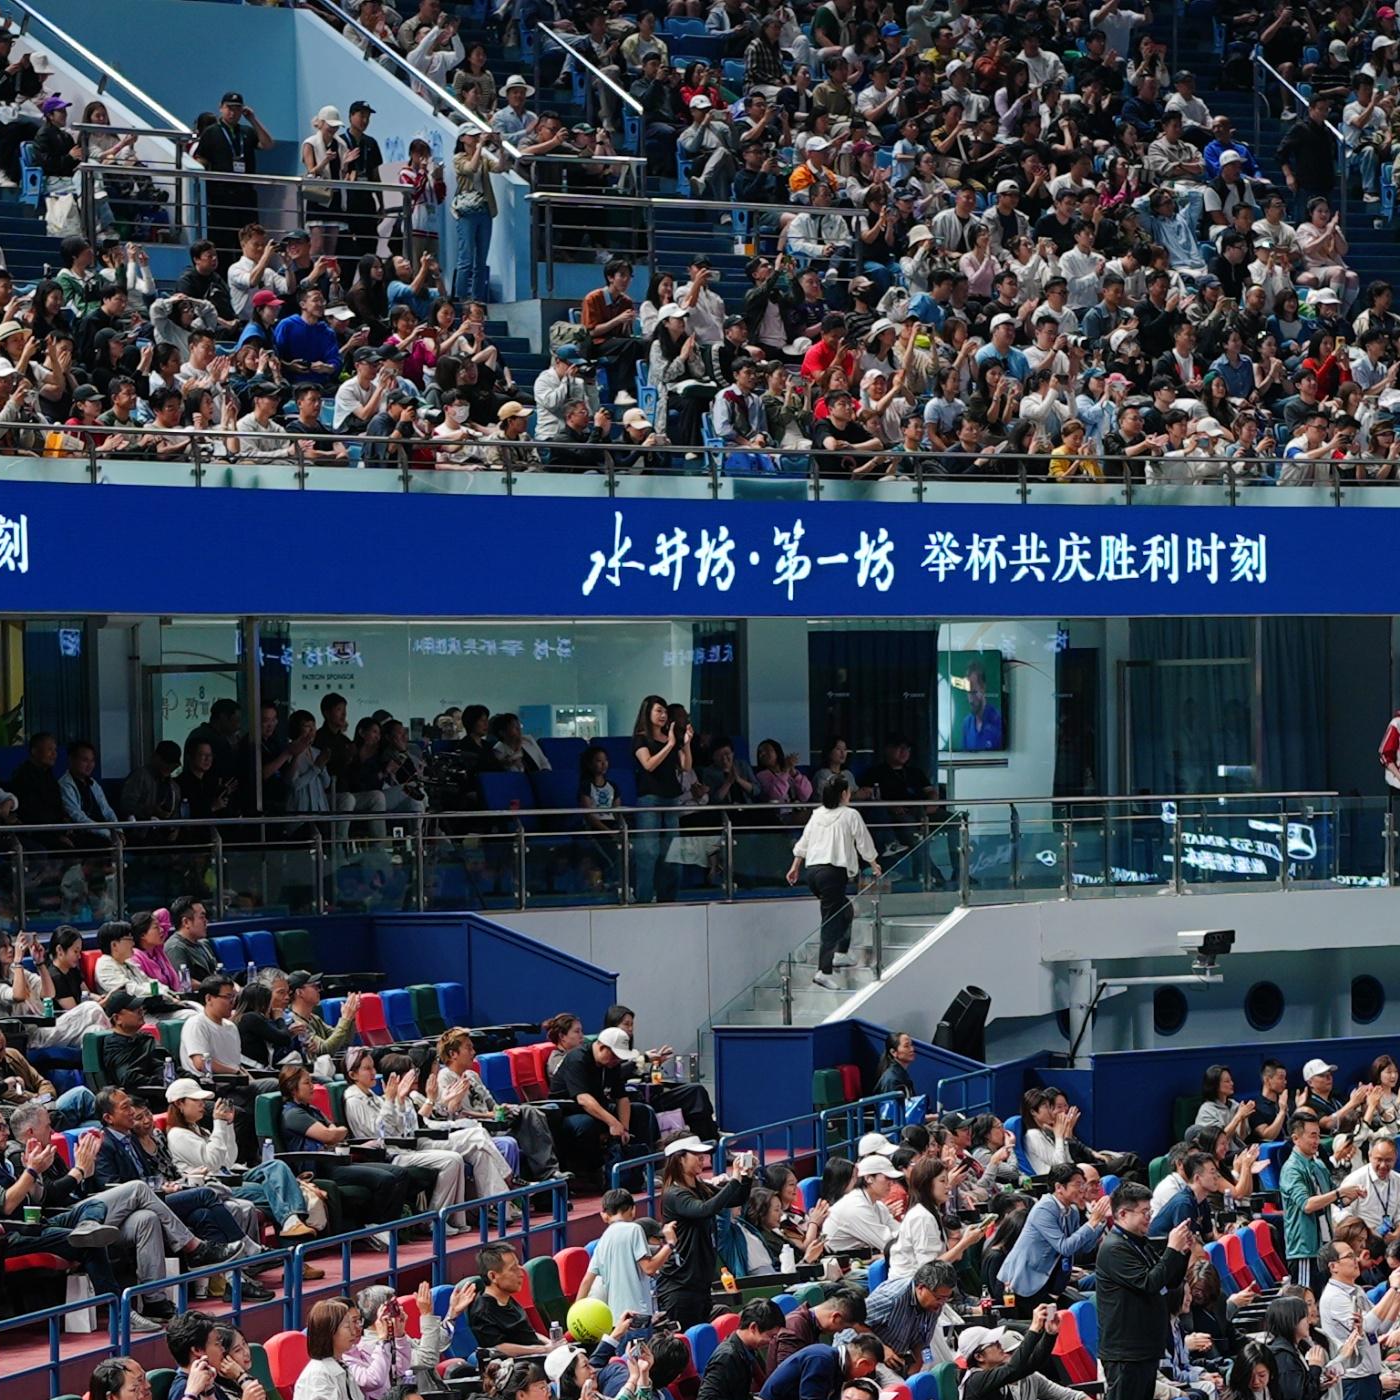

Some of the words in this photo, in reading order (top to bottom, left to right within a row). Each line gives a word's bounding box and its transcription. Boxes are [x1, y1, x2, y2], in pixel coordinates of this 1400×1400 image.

[581, 510, 896, 601] 水井坊·第一坊
[920, 531, 1268, 584] 举杯共庆胜利时刻
